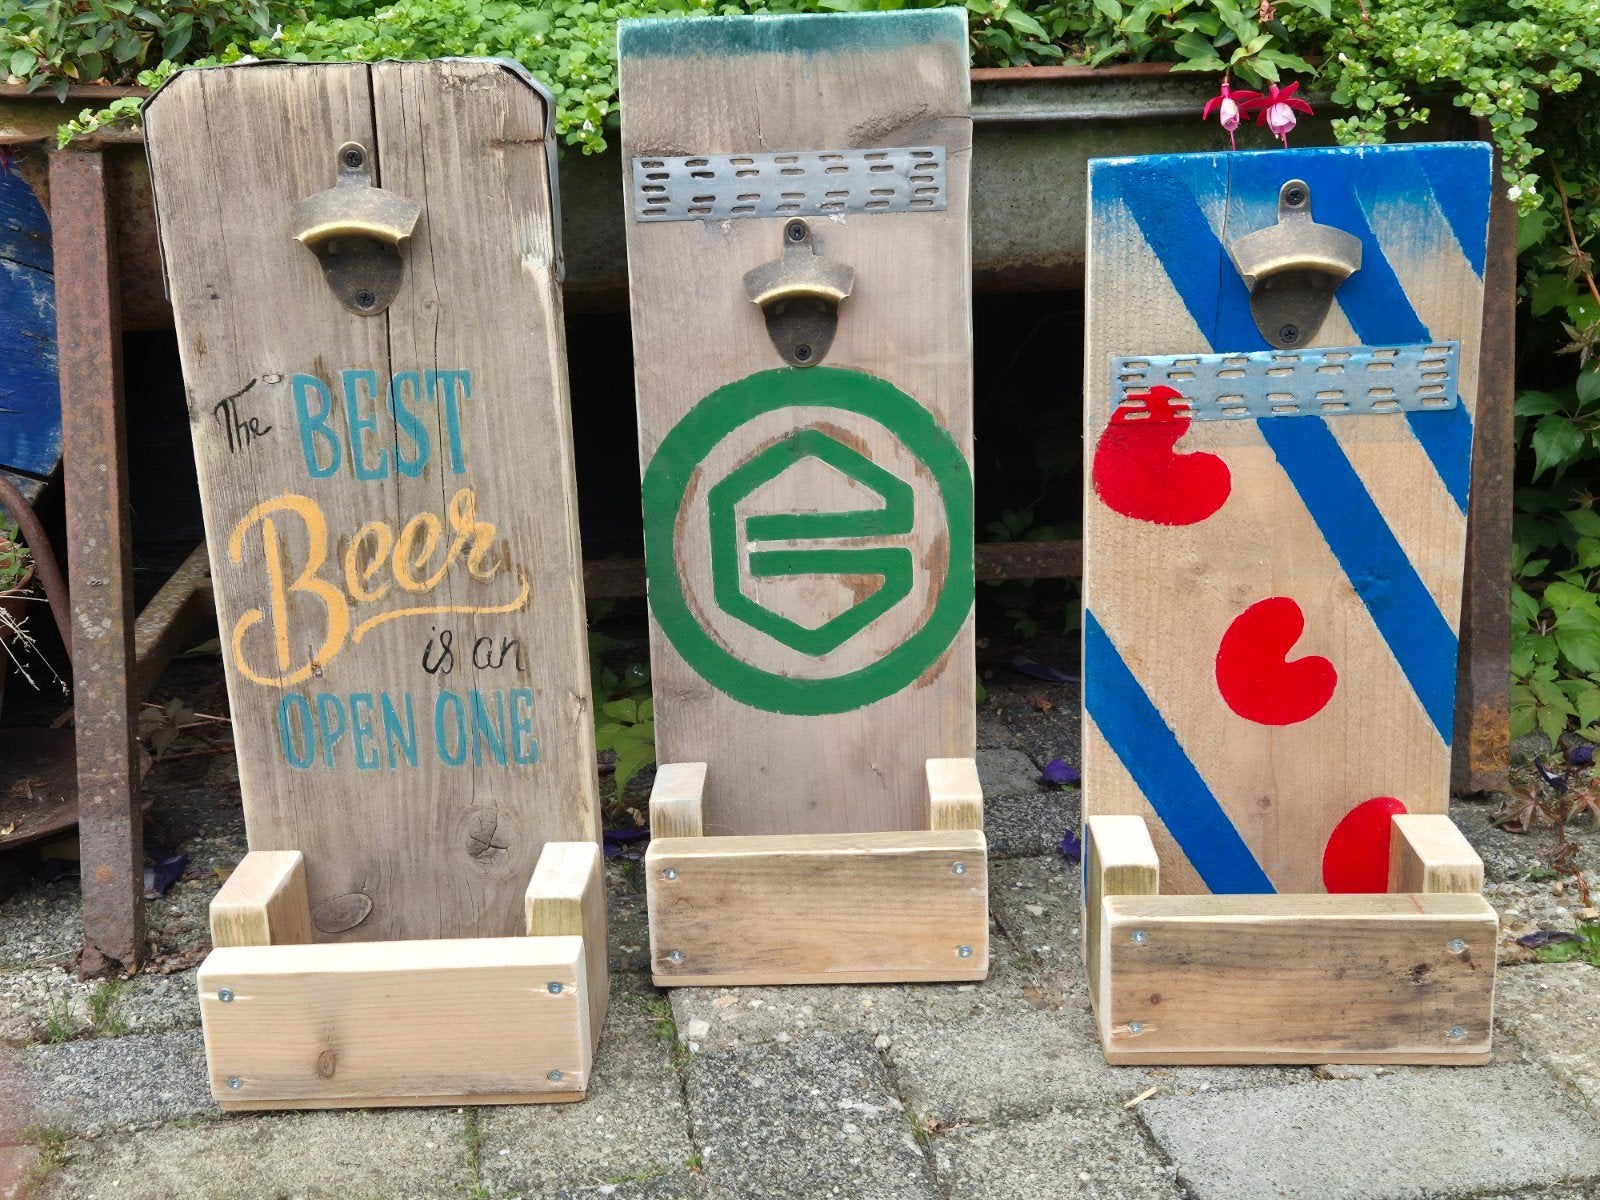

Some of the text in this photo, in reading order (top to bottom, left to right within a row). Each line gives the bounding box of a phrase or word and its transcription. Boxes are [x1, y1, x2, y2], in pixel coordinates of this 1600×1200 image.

[213, 368, 472, 481] The BEST
[228, 487, 531, 688] Beer
[422, 625, 526, 675] is an
[277, 687, 540, 770] OPEN ONE
